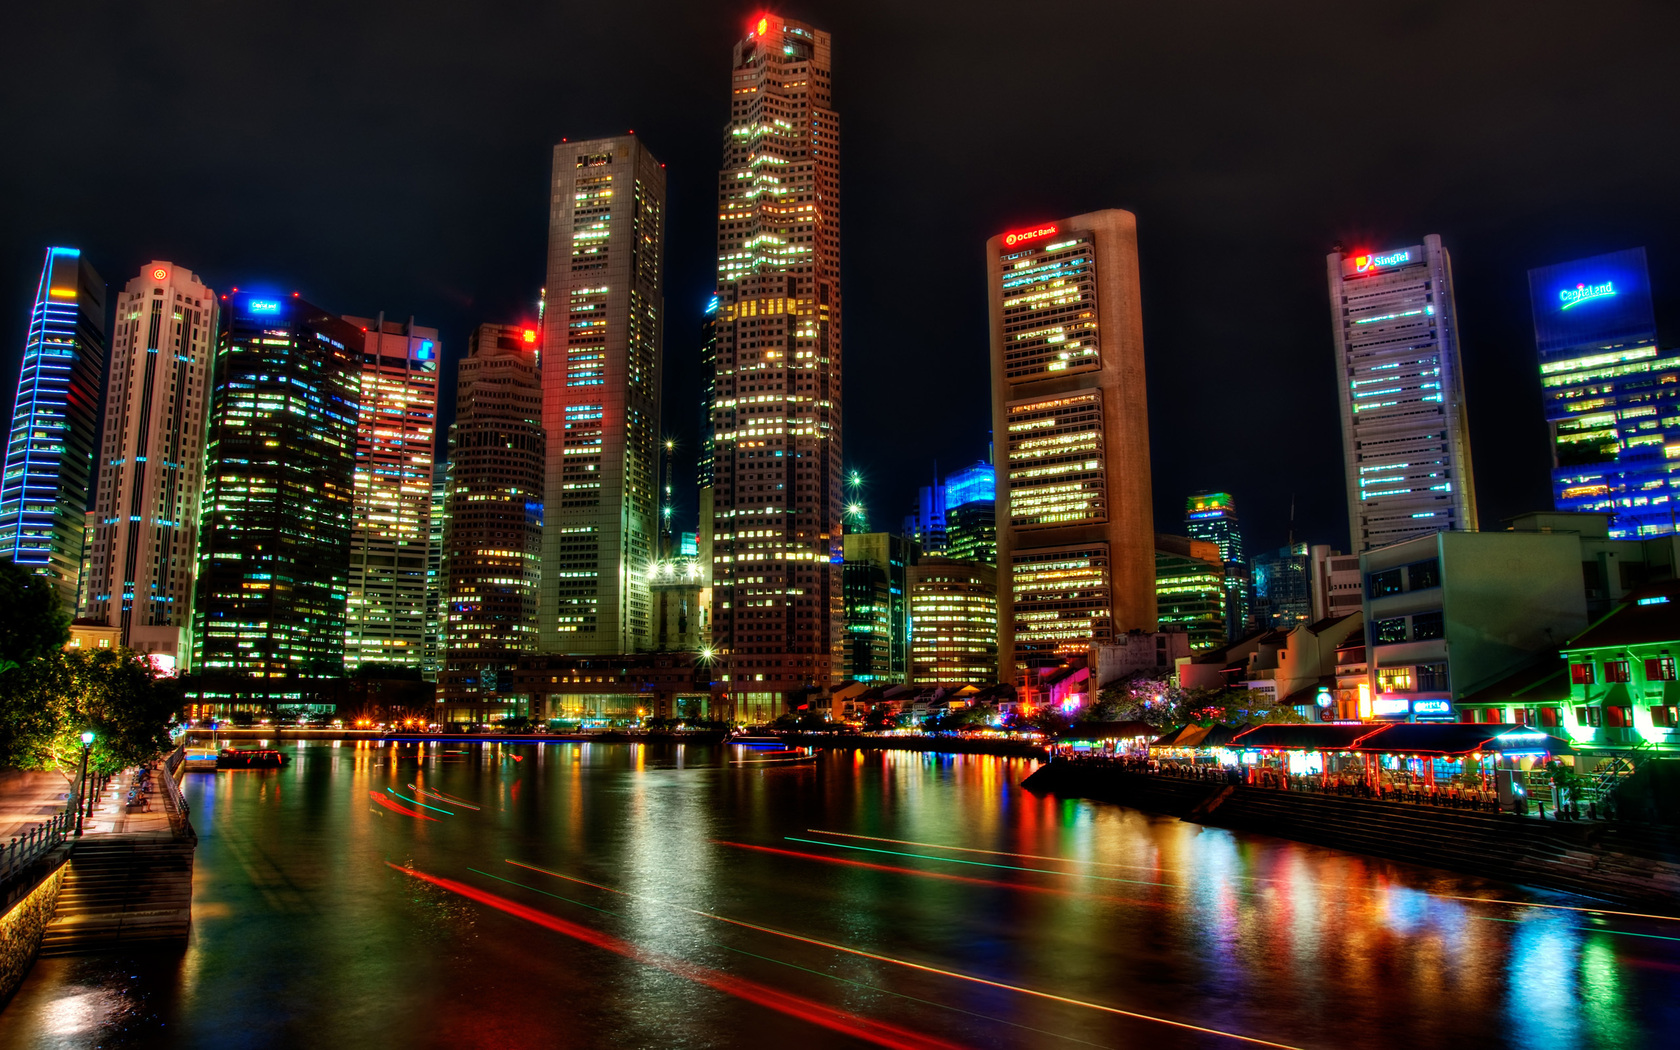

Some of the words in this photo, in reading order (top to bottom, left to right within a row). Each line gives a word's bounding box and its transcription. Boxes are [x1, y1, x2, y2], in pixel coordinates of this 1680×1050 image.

[1017, 230, 1037, 241] OCBC
[1038, 226, 1056, 236] Bank
[1374, 252, 1409, 266] SingTel
[1560, 281, 1613, 301] CapitaLand
